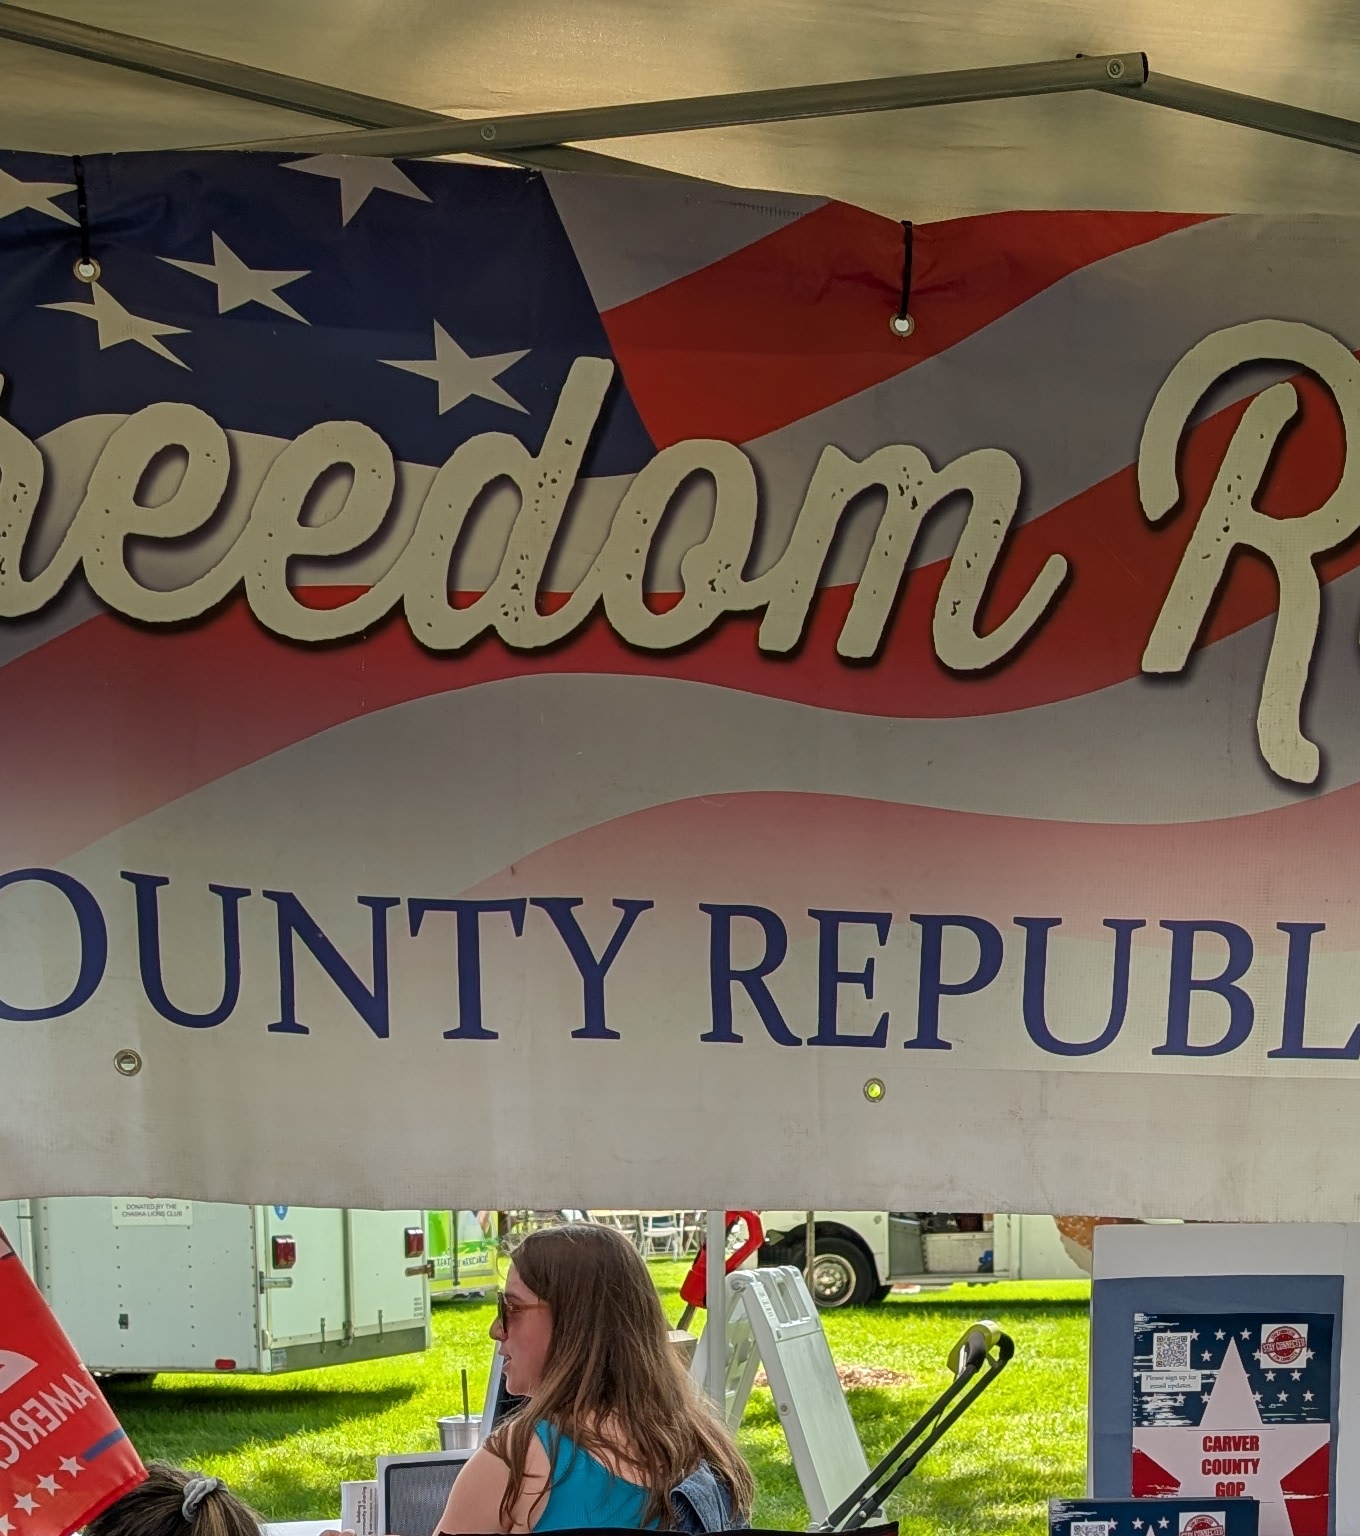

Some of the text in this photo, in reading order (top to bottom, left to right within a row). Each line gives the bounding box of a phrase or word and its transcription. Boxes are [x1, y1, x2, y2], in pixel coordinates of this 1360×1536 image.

[1203, 1435, 1260, 1452] CARVER
[1201, 1458, 1260, 1475] COUNTY
[1215, 1482, 1246, 1497] GOP
